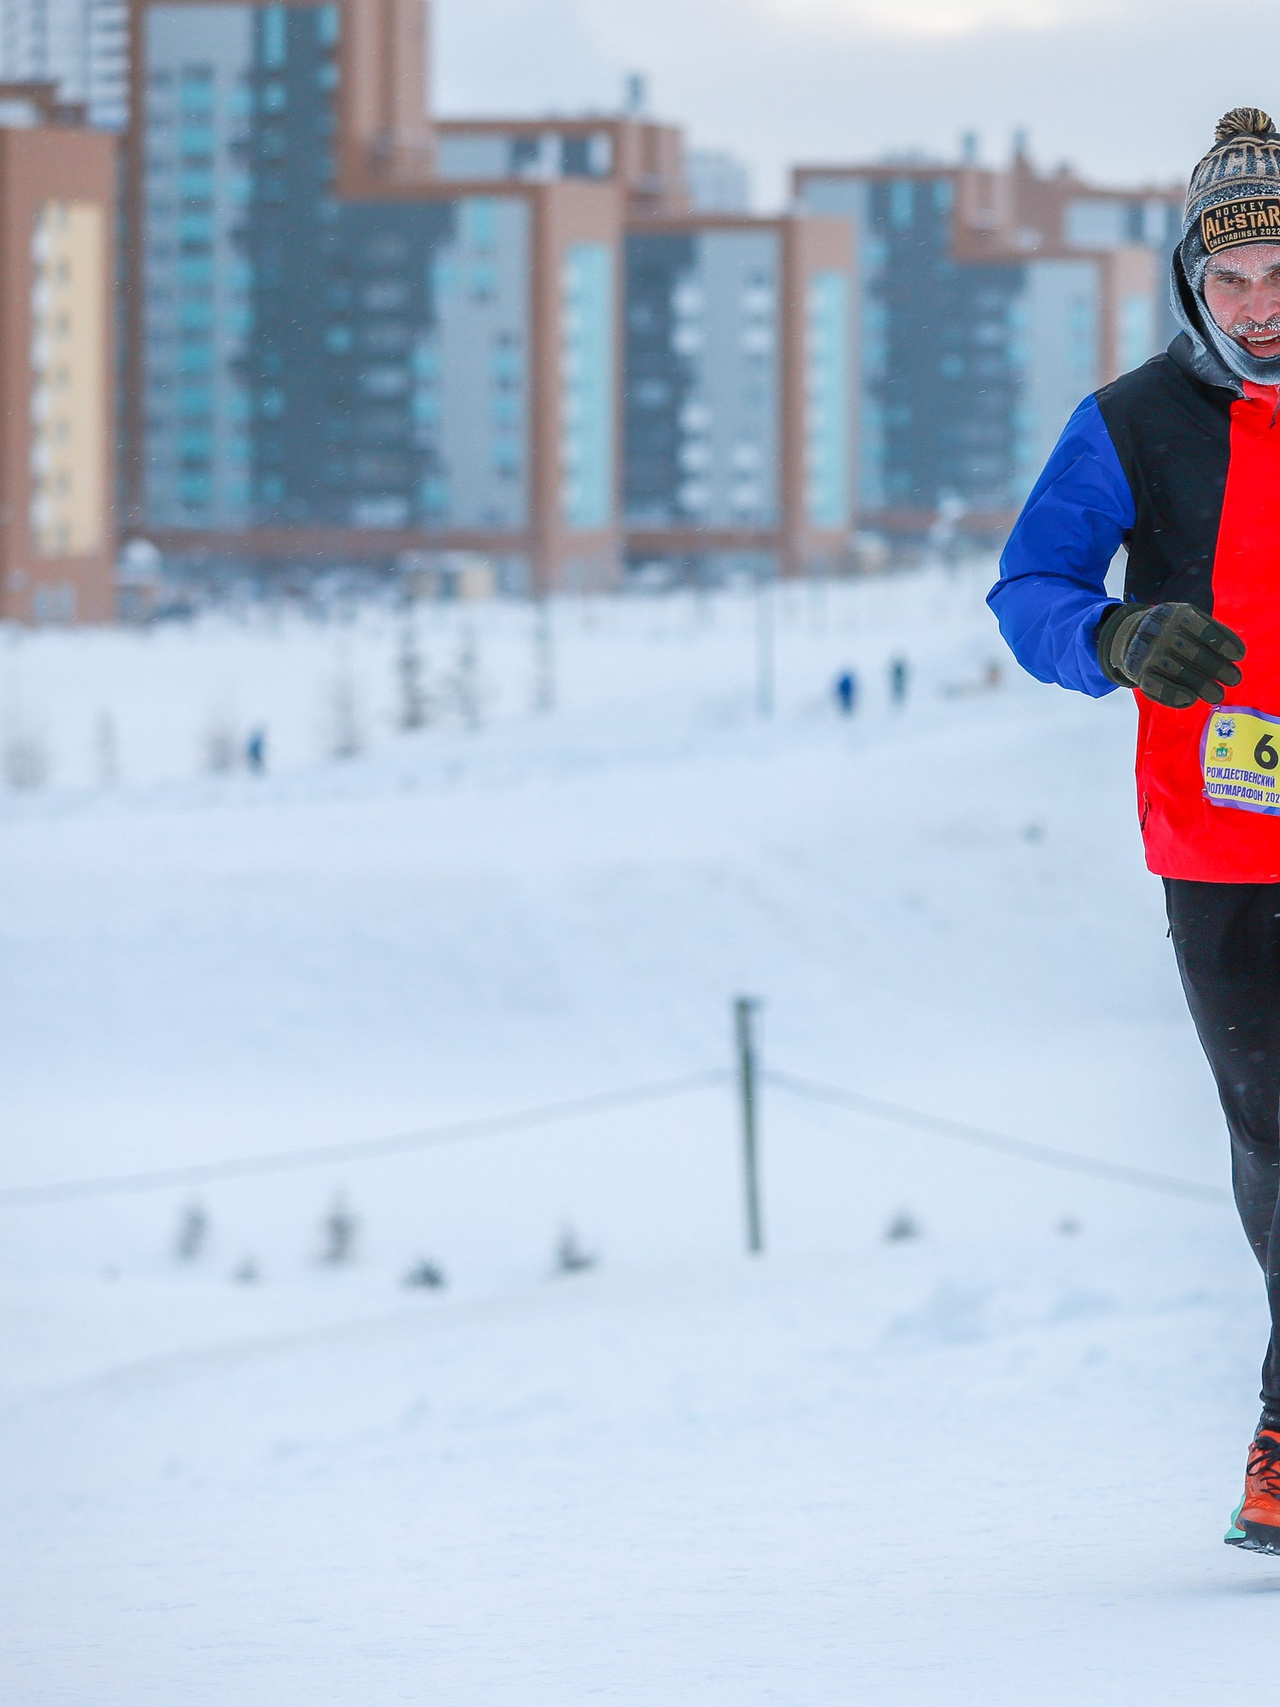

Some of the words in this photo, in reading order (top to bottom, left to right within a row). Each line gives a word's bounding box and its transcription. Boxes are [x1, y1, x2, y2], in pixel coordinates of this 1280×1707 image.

[1215, 201, 1265, 219] HOCKEY
[1209, 229, 1258, 248] CHELYABINSK
[1206, 766, 1276, 789] РОЖДЕСТВЕНСКИЙ
[1206, 781, 1264, 801] ПОЛУМАРАФОН
